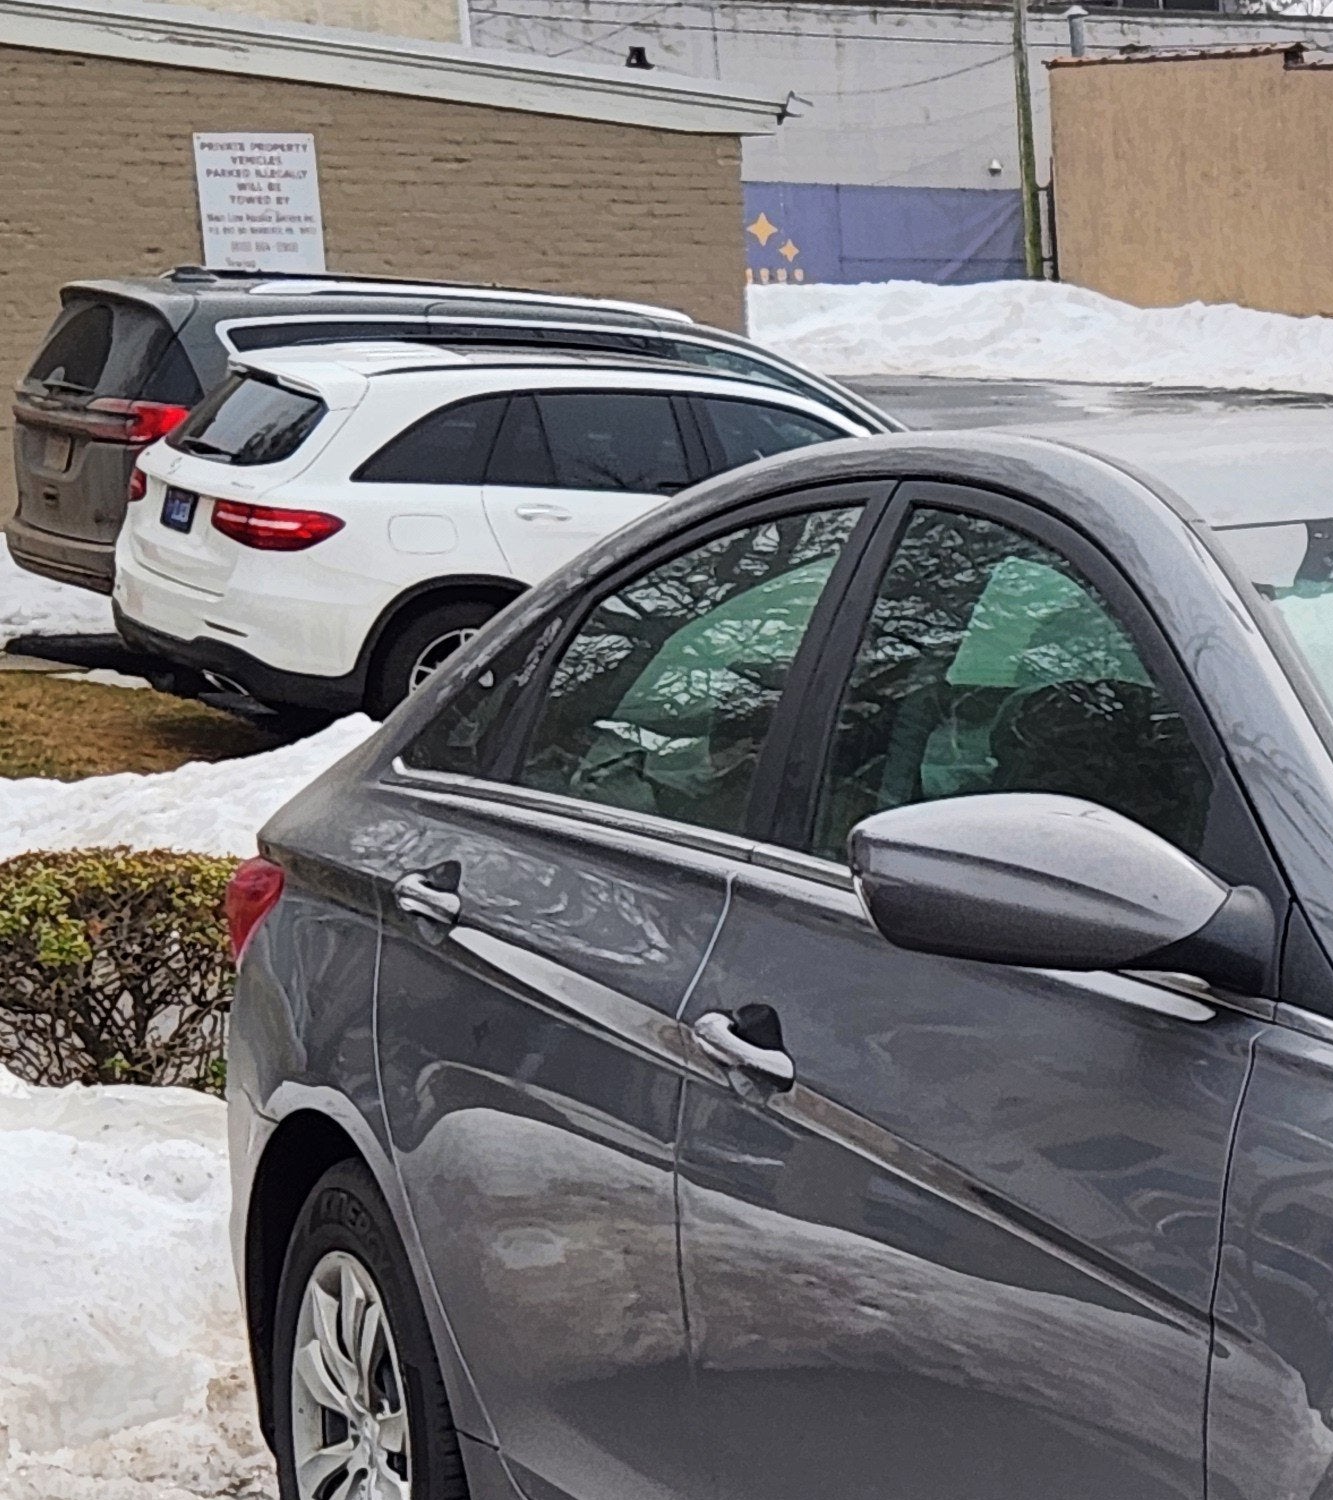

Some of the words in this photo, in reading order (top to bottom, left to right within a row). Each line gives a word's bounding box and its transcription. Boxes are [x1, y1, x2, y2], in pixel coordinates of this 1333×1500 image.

[200, 142, 245, 152] PRIVATE
[250, 142, 307, 153] PROPERTY
[230, 155, 282, 166] VEHICLES
[205, 168, 250, 178] PARKED
[236, 182, 262, 192] WILL
[267, 182, 282, 192] BE
[229, 195, 271, 205] TOWED
[276, 196, 290, 205] BY
